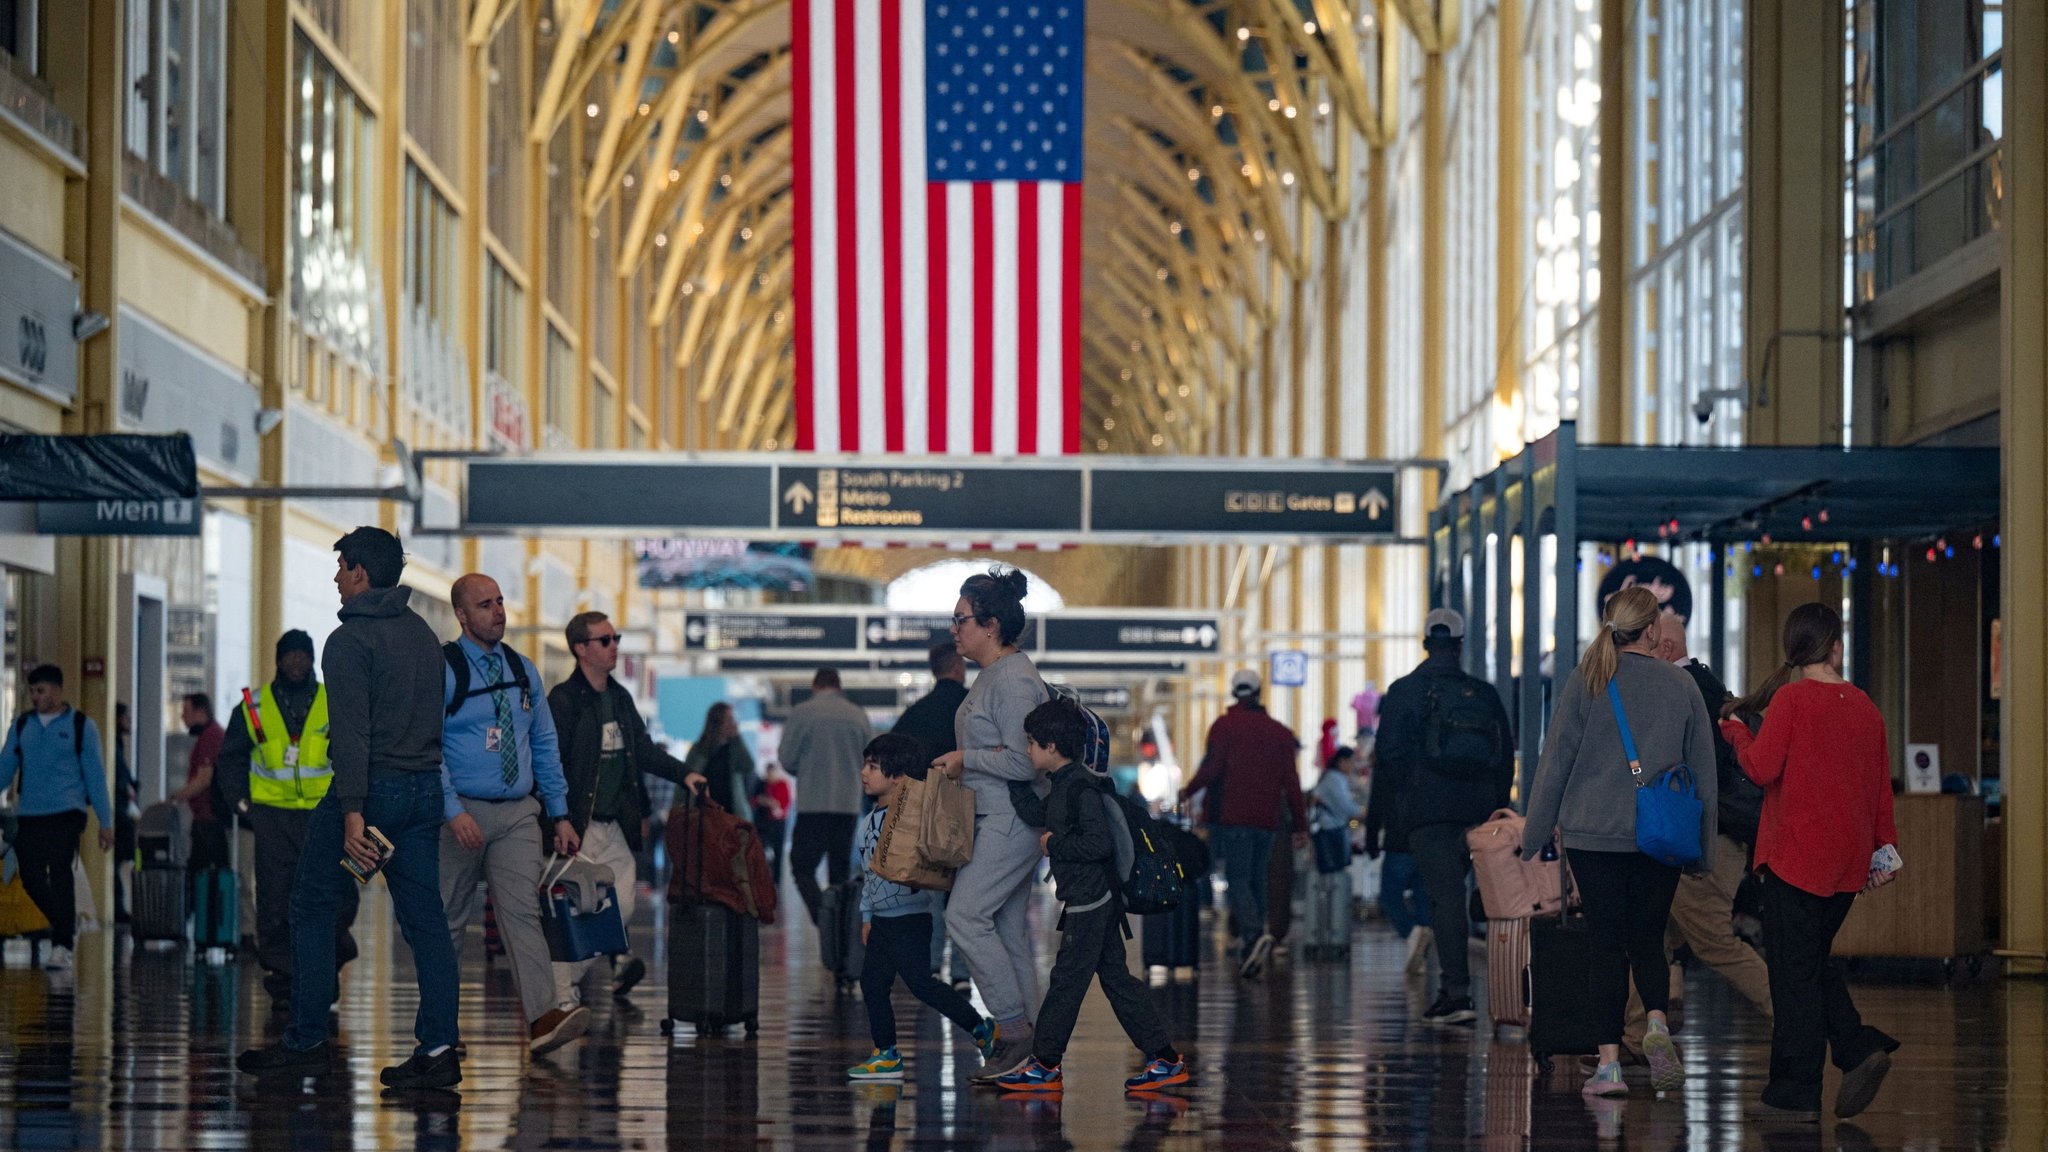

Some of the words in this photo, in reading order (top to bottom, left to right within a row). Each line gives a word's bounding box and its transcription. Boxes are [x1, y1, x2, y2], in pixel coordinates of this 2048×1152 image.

[841, 471, 888, 488] South
[890, 471, 949, 492] Parking
[952, 471, 965, 489] 2
[841, 491, 891, 506] Metro
[1287, 493, 1333, 511] Gates
[97, 499, 158, 521] Men
[840, 506, 923, 526] Restrooms
